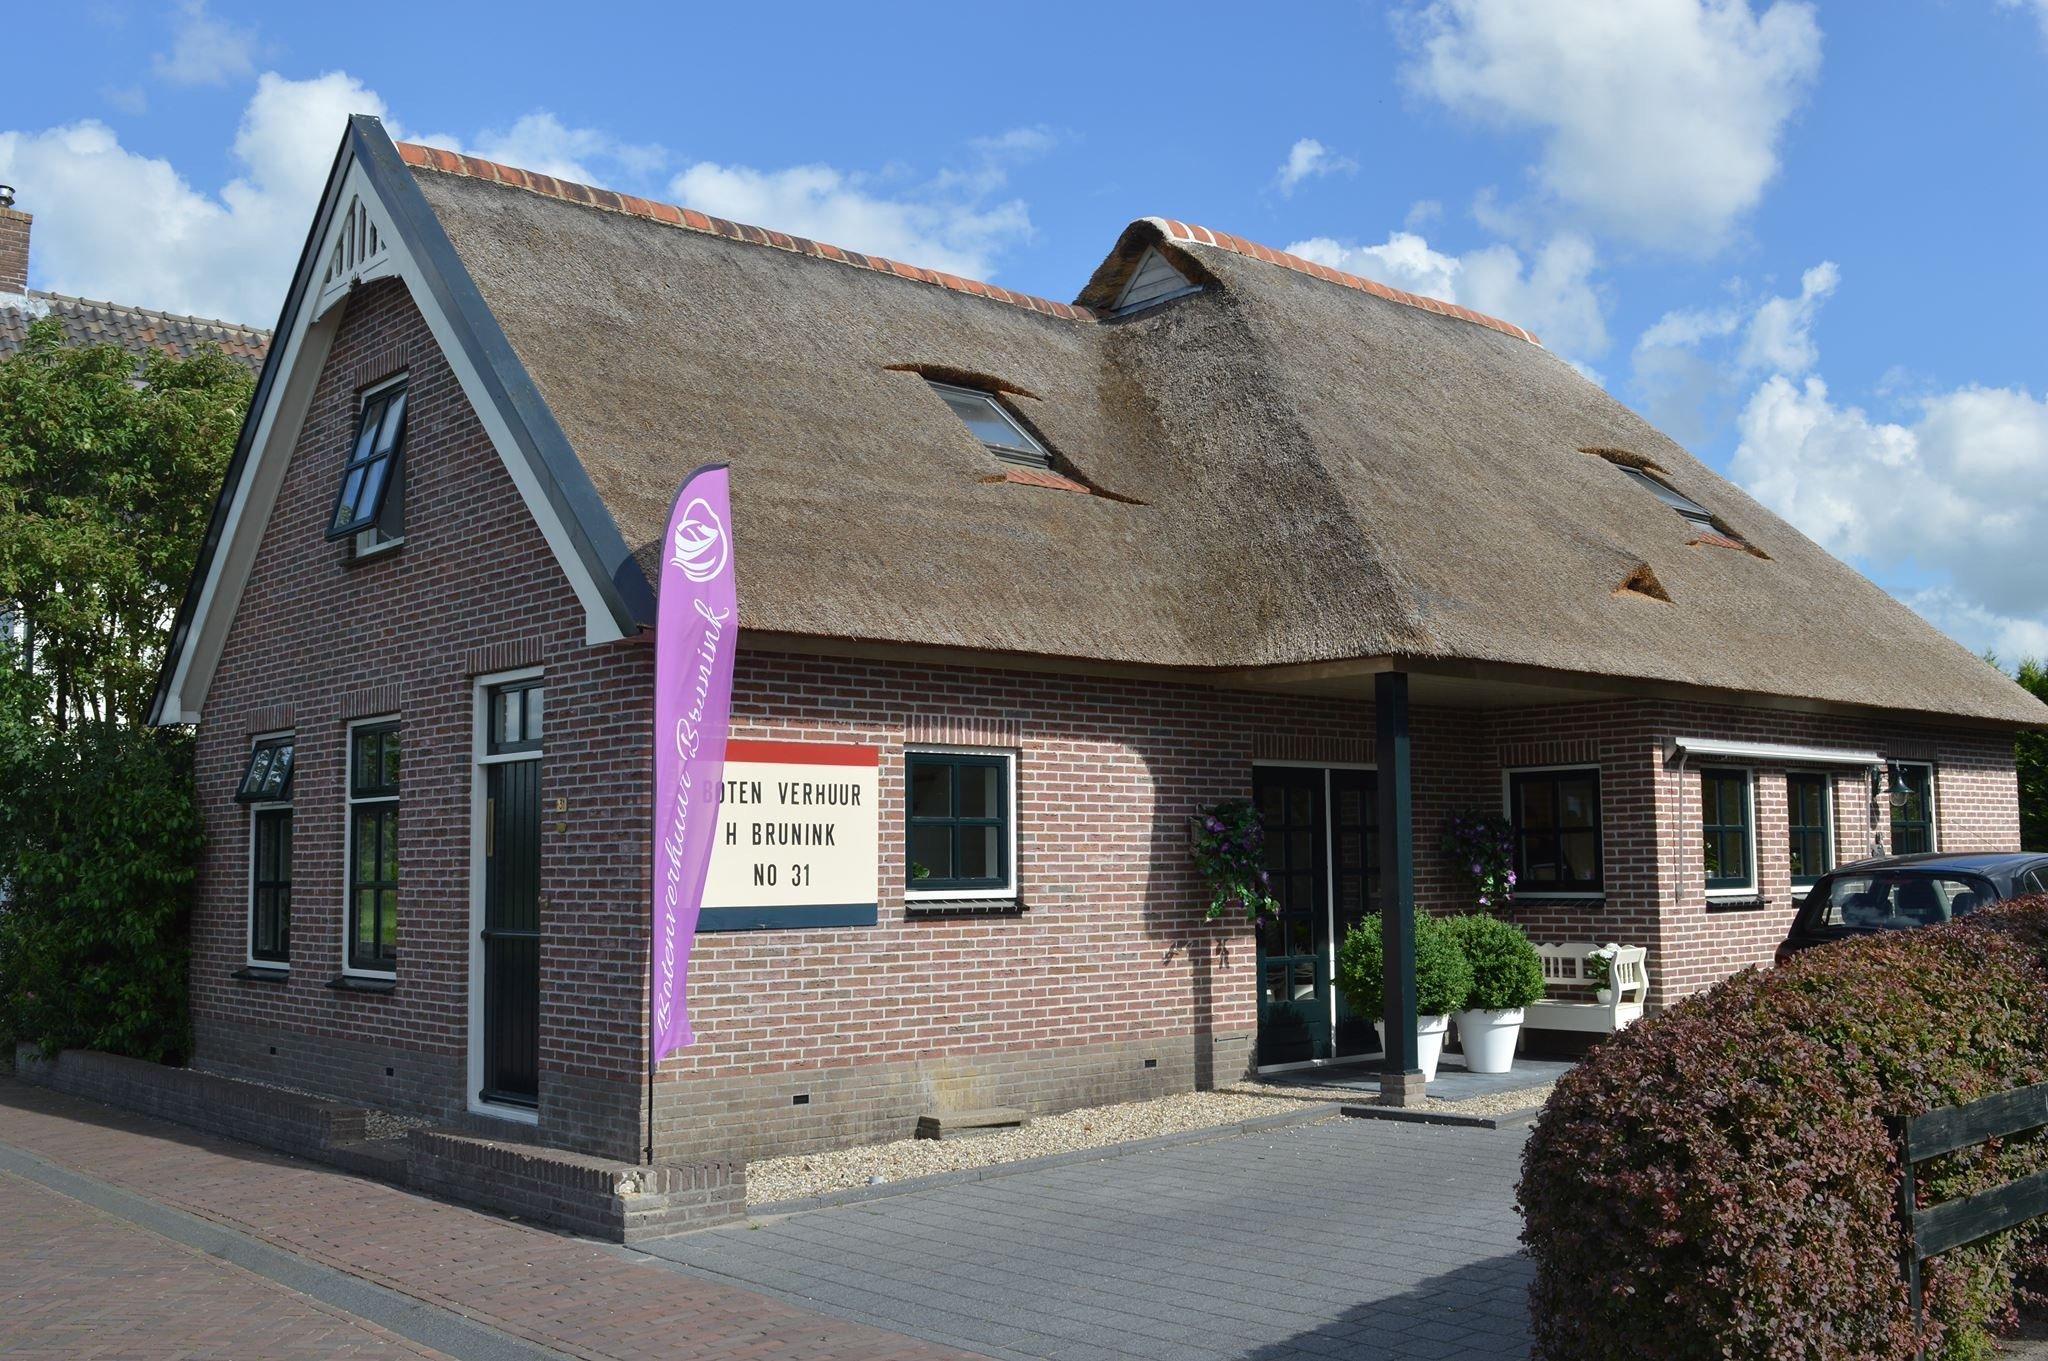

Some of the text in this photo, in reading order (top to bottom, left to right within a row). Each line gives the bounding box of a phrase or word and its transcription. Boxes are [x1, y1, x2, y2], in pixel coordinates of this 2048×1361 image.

[778, 781, 861, 806] VERHUUR
[656, 598, 730, 1037] Botenverhuur Brunink
[725, 822, 836, 846] H BRUNINK
[753, 863, 810, 886] NO 31
